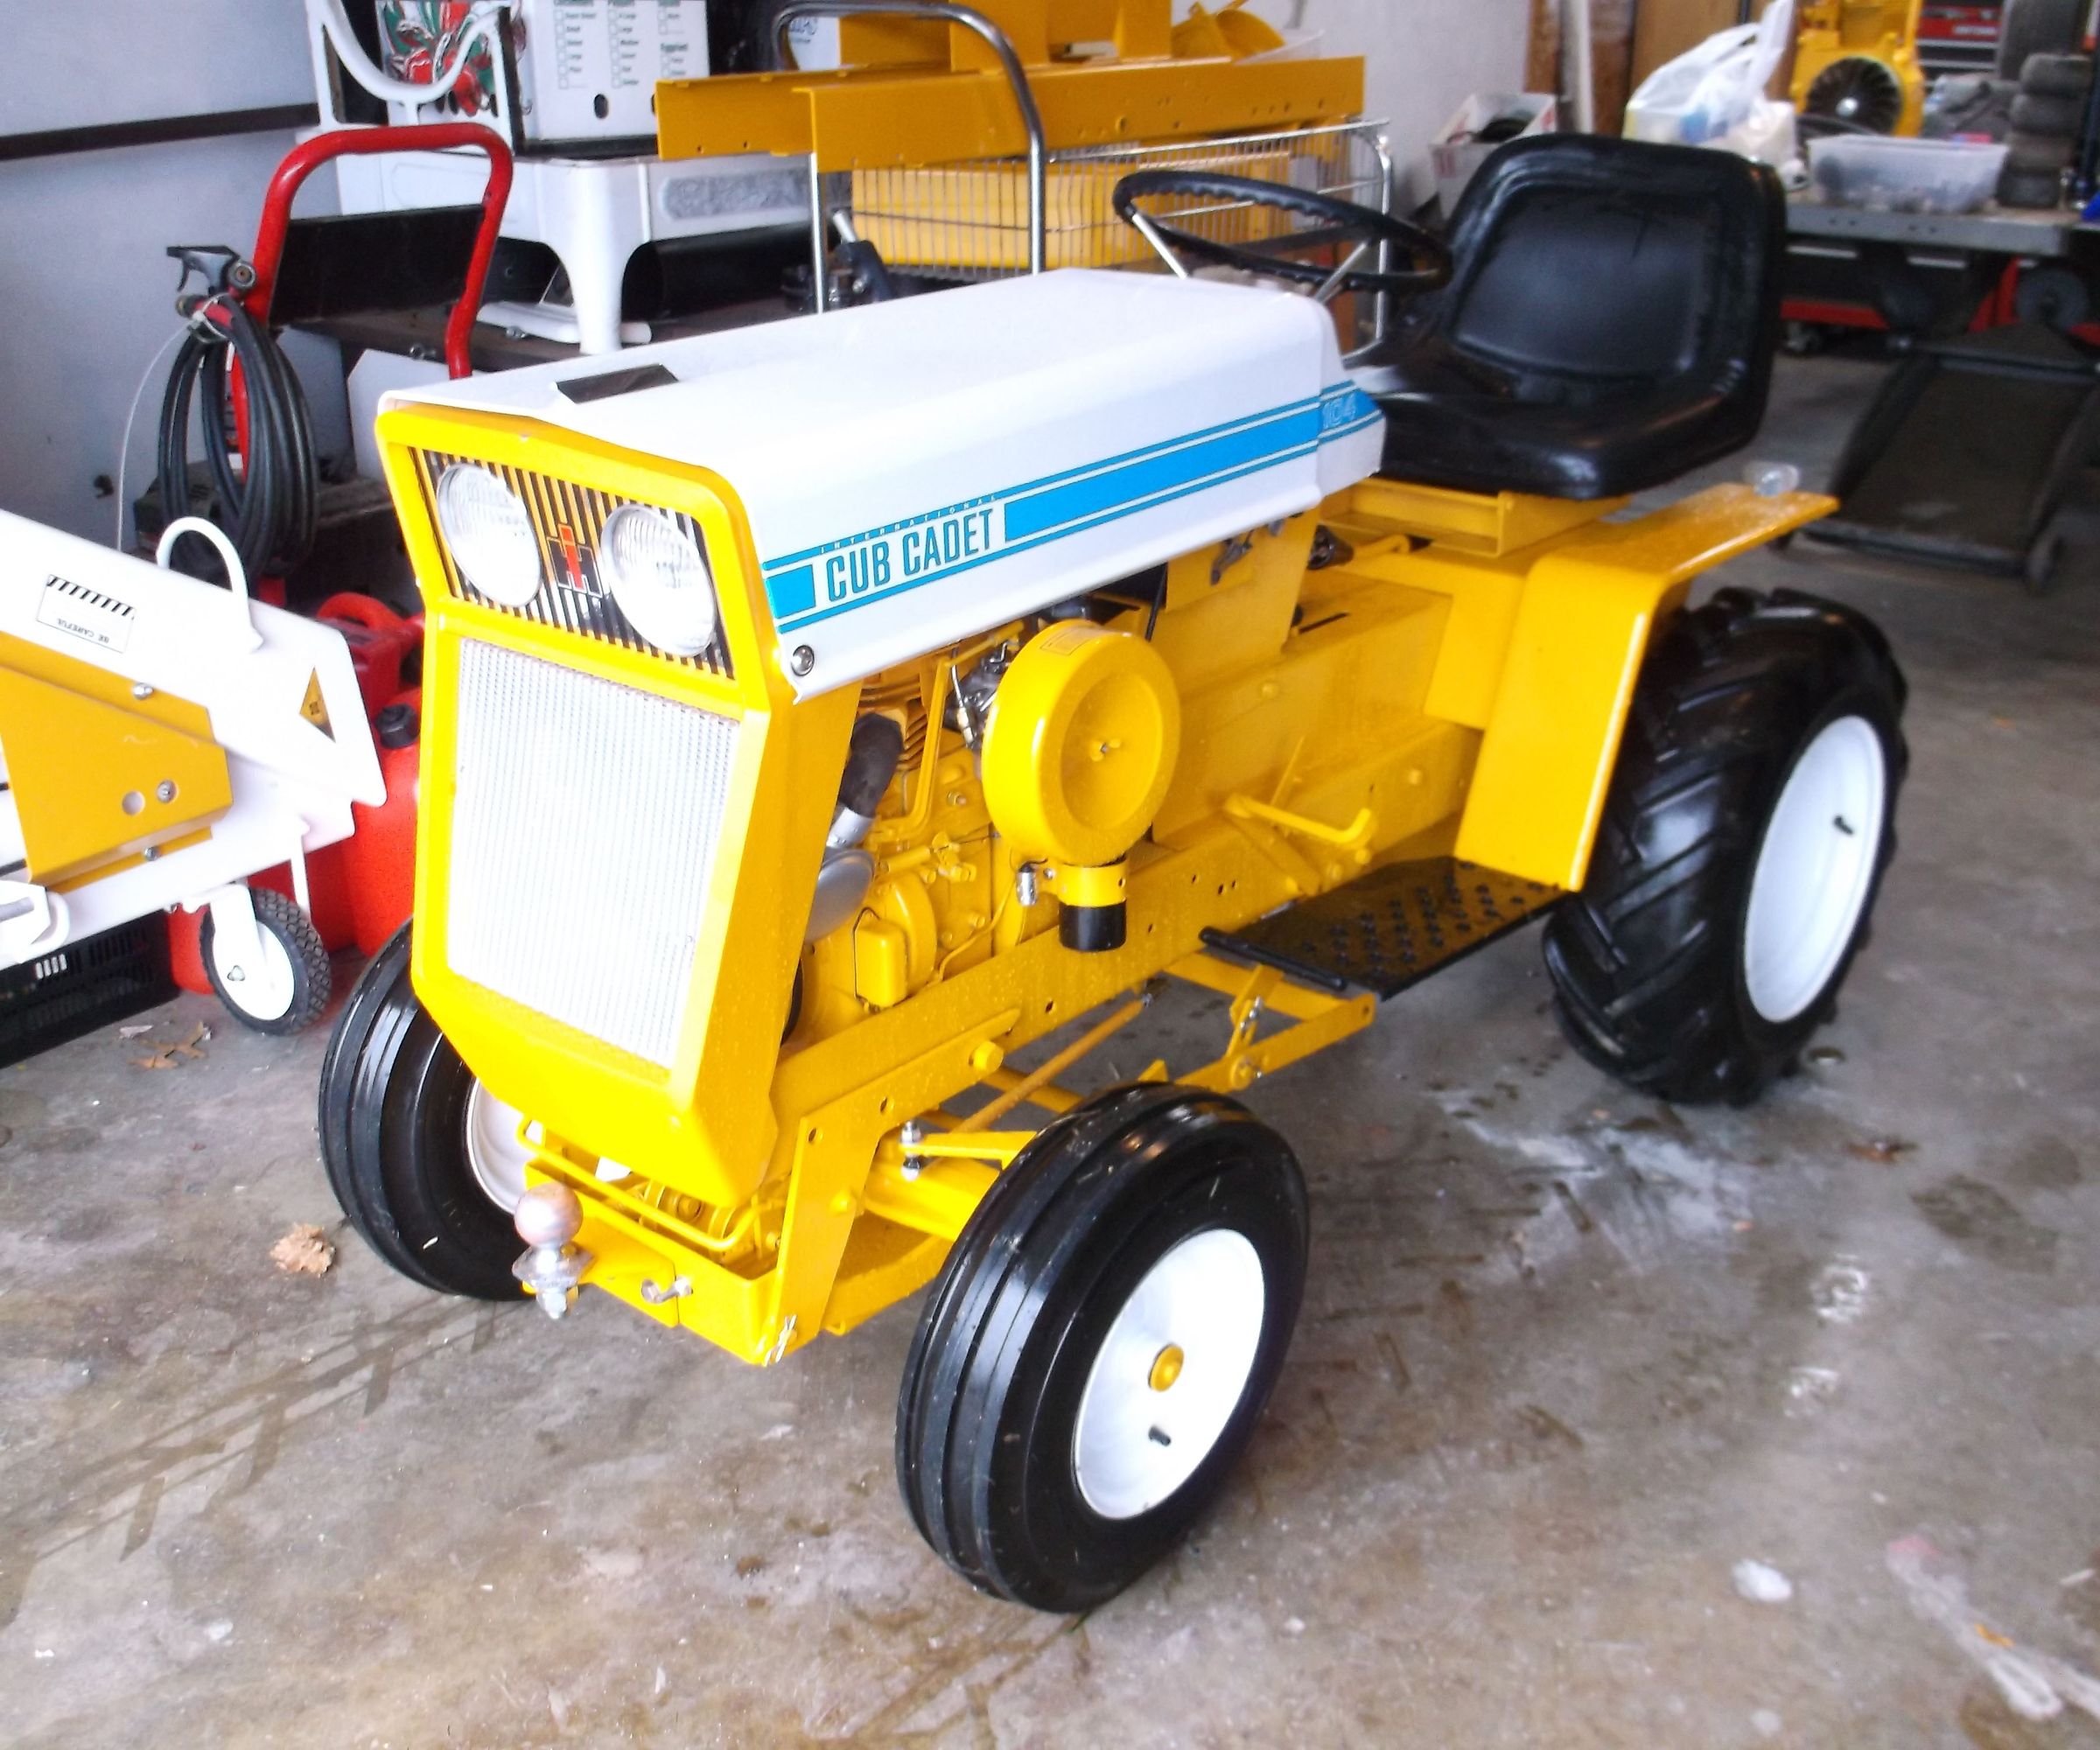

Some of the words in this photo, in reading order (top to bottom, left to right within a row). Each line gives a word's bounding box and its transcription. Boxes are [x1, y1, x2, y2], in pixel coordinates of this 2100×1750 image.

[821, 494, 997, 554] INTERNATIONAL
[826, 541, 891, 602] CUB
[902, 508, 993, 576] CADET
[57, 618, 94, 638] CAREFUL
